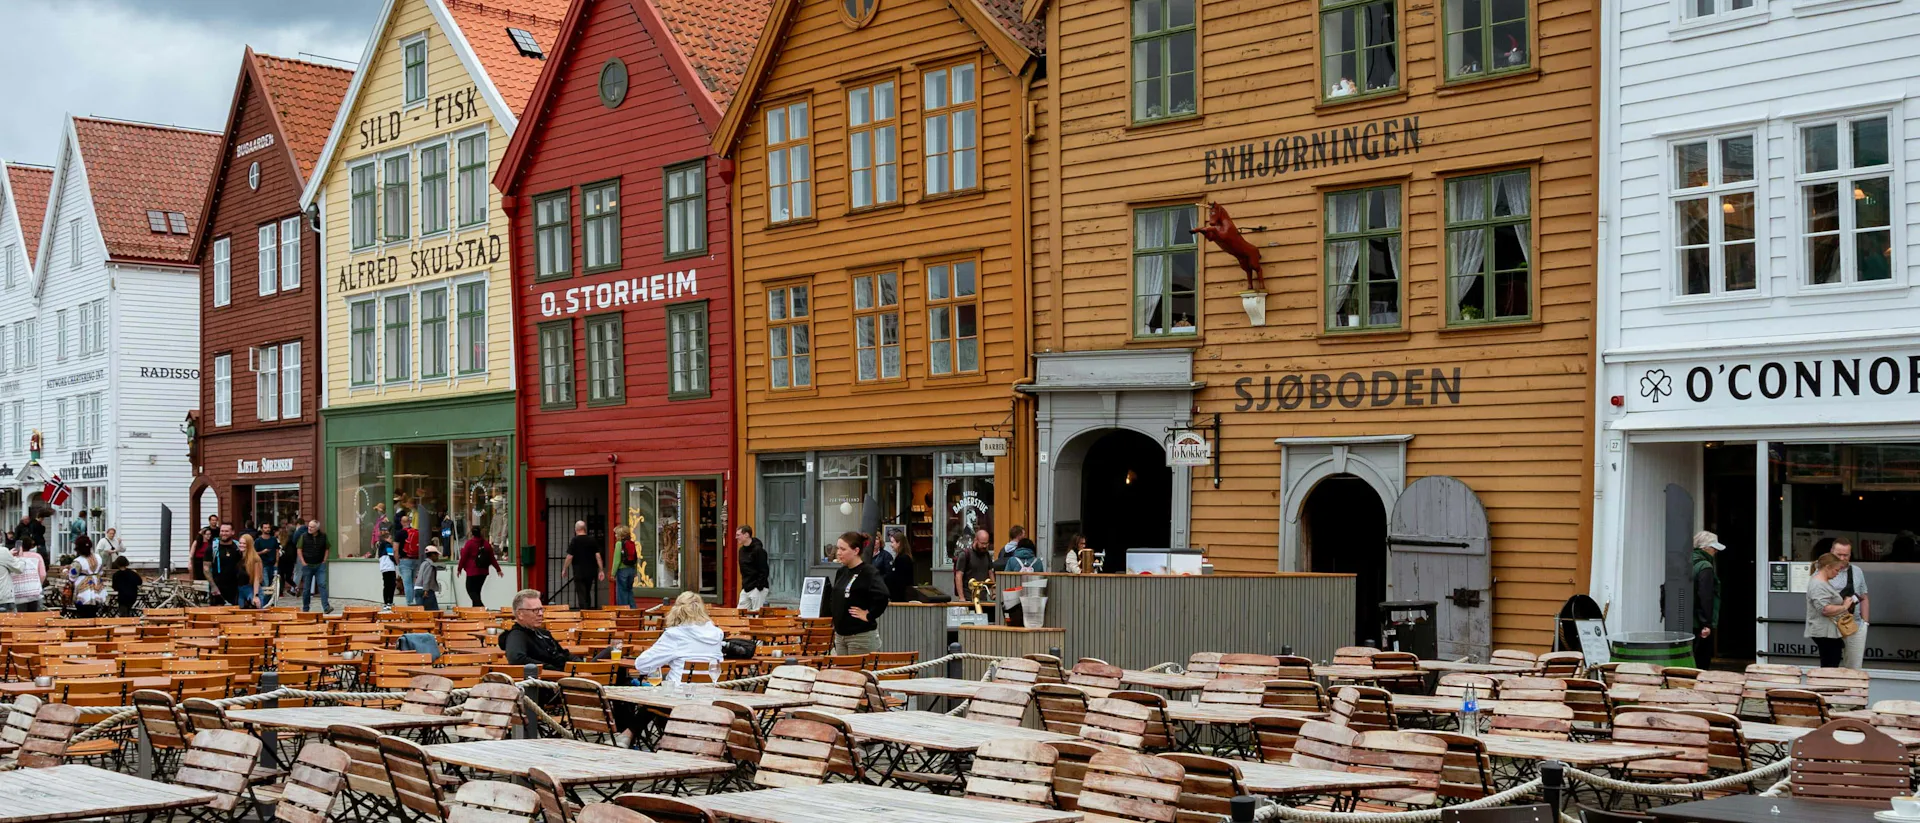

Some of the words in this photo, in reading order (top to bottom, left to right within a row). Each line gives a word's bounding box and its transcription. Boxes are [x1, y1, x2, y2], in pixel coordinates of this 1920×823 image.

[361, 110, 401, 149] SILD
[434, 85, 479, 129] FISK
[236, 133, 274, 158] BUGAARDEN
[1204, 116, 1421, 185] ENHJØRNINGEN
[338, 255, 398, 292] ALFRED
[410, 234, 501, 279] SKULSTAD
[540, 291, 562, 317] O.
[565, 269, 698, 314] STORHEIM
[1234, 367, 1461, 412] SJØBODEN
[984, 443, 1005, 451] BARBER
[60, 466, 79, 480] SILVER
[81, 464, 109, 479] GALLERY
[952, 496, 989, 514] BARBERSTUE
[1773, 643, 1806, 655] IRISH
